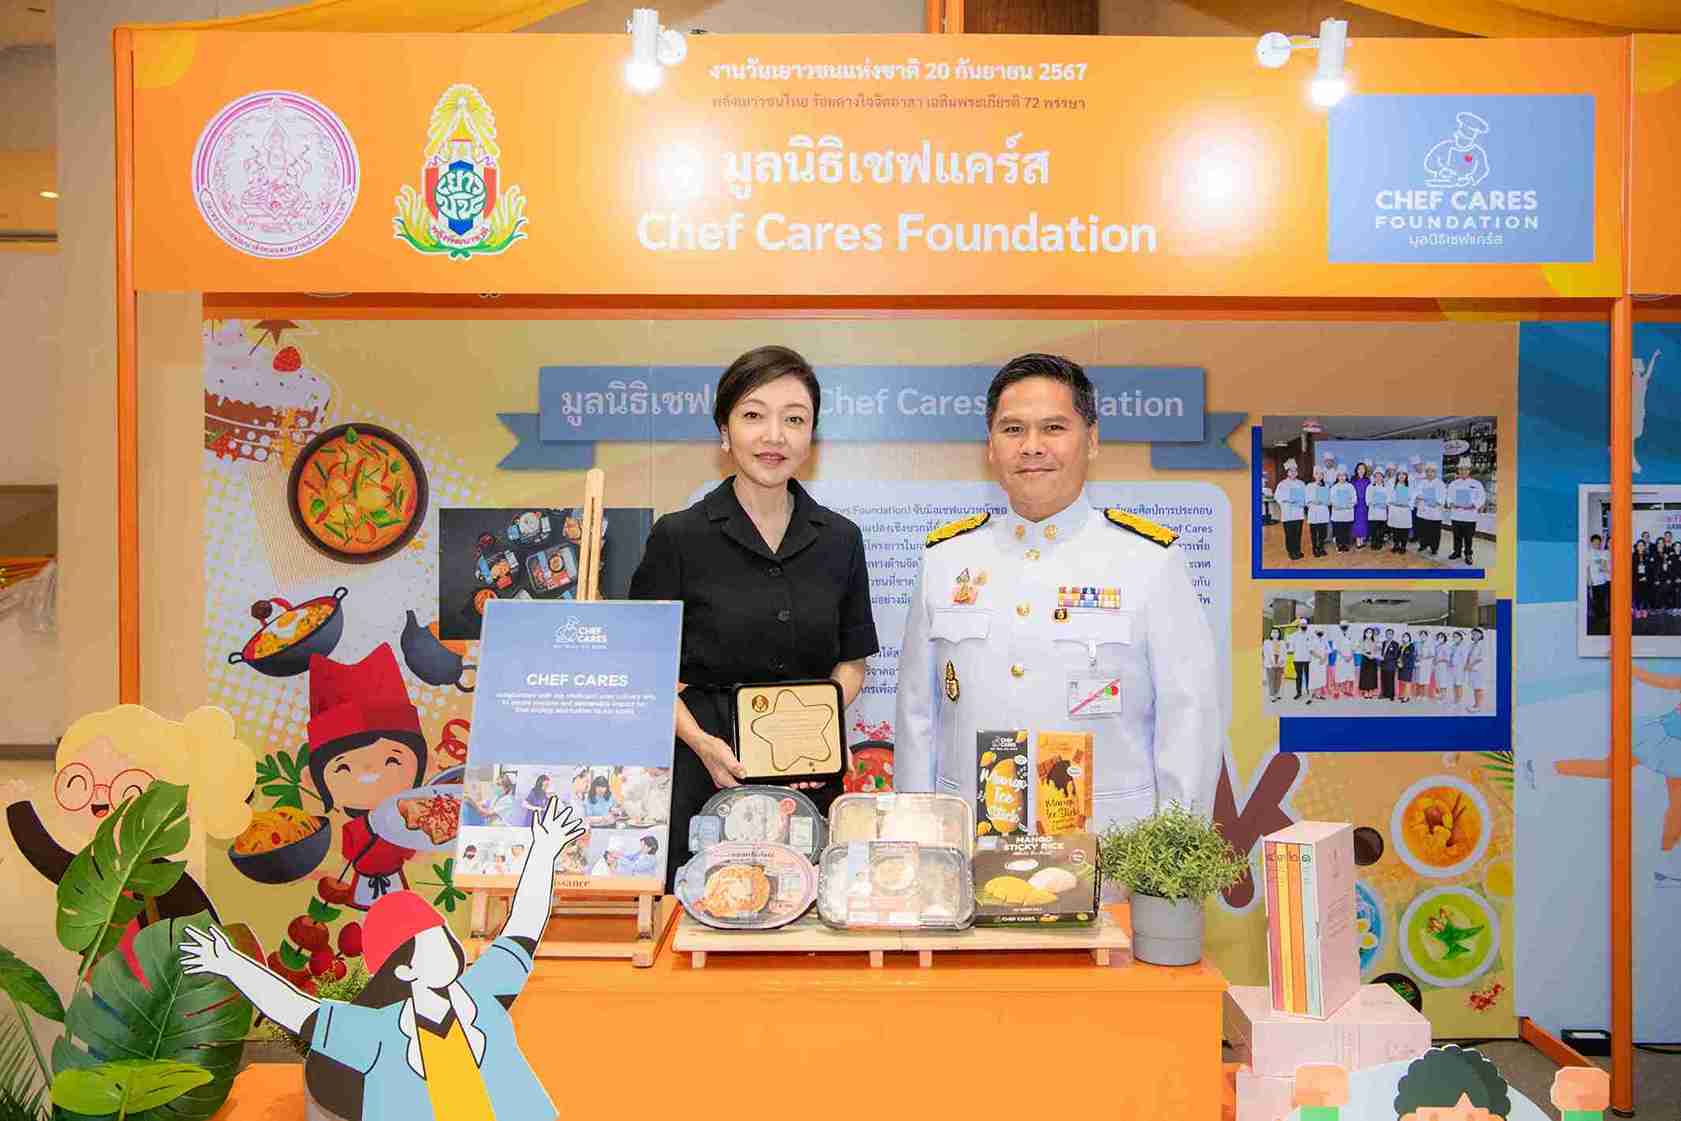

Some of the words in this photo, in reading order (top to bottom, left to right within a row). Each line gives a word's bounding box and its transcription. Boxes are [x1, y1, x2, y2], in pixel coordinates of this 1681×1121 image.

[926, 62, 949, 81] 20
[955, 60, 1033, 81] กันยายน
[1039, 62, 1088, 81] 2567
[1024, 100, 1040, 109] 72
[720, 132, 1051, 199] มูลนิธิเชฟแคร์ส
[1375, 189, 1444, 211] CHEF
[1451, 189, 1538, 211] CARES
[637, 212, 745, 252] Chef
[755, 212, 884, 252] Cares
[898, 211, 1158, 253] Foundation
[1375, 215, 1539, 230] FOUNDATION
[561, 379, 717, 427] มูลนิธิเชฟ
[897, 388, 988, 416] Cares
[1095, 388, 1184, 417] ation
[526, 673, 569, 687] CHEF
[574, 673, 629, 688] CARES
